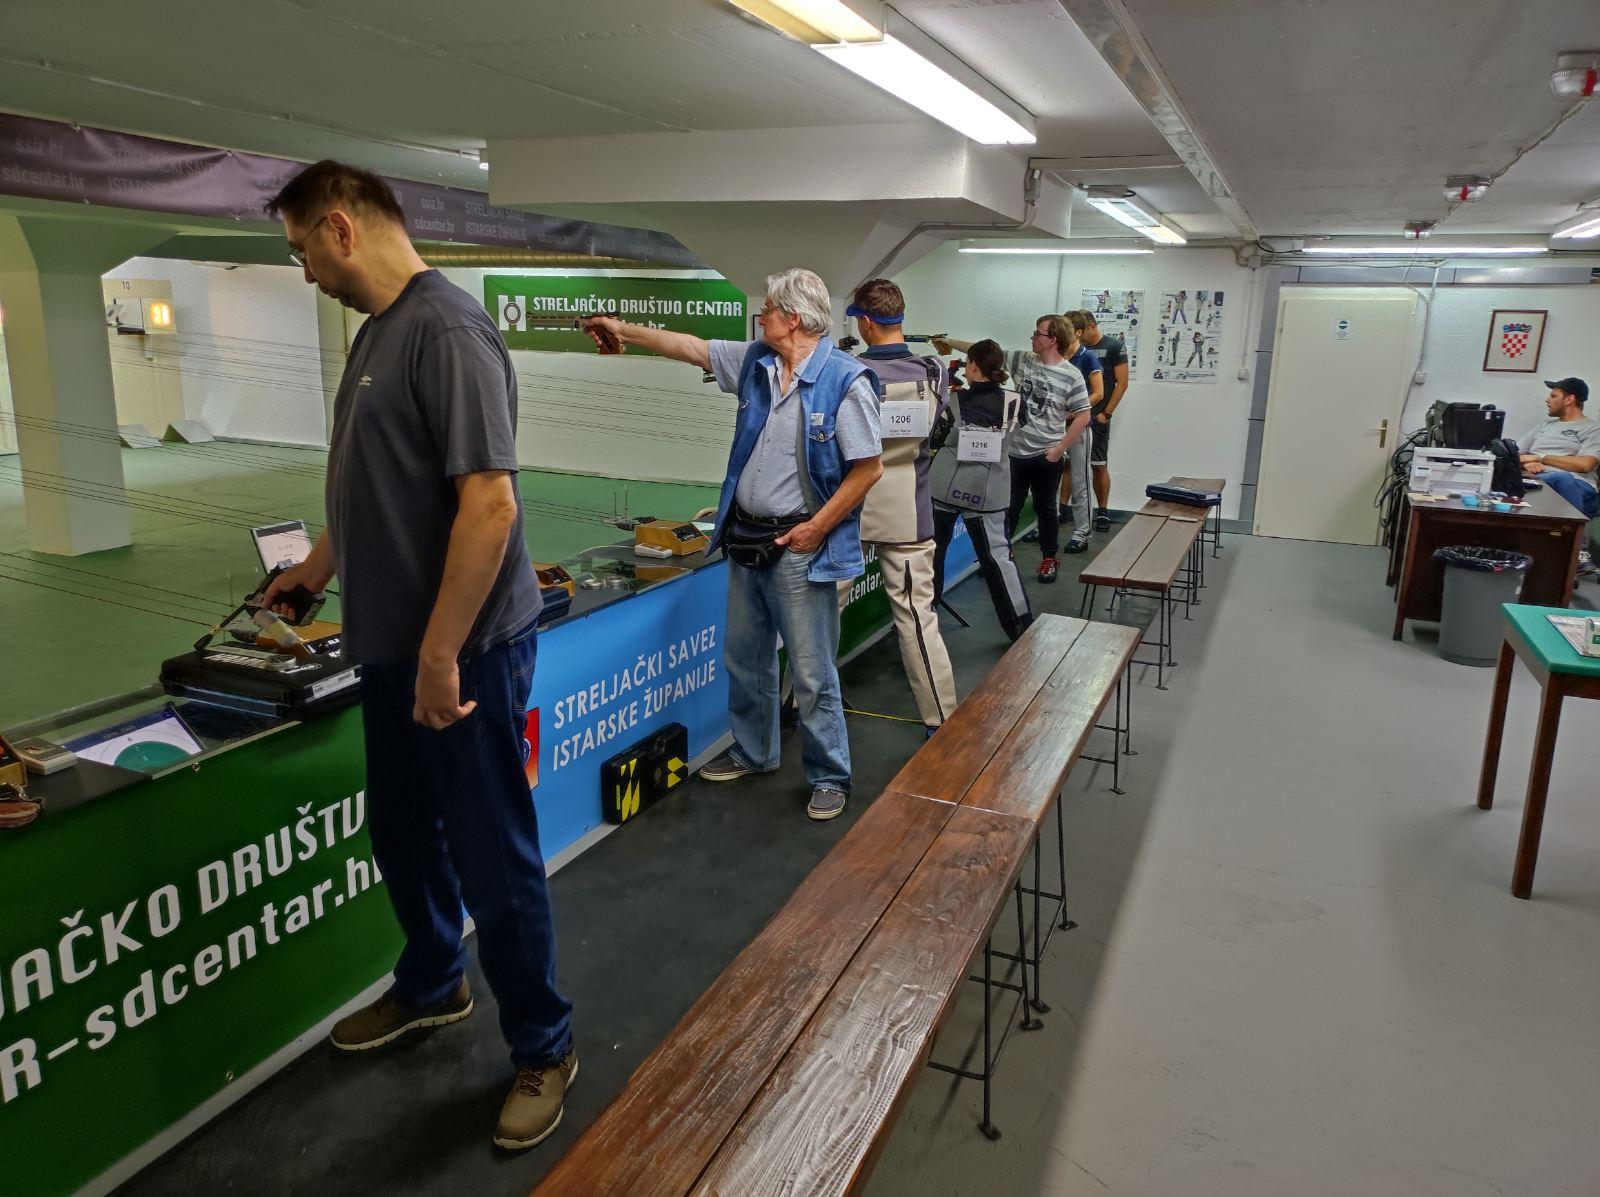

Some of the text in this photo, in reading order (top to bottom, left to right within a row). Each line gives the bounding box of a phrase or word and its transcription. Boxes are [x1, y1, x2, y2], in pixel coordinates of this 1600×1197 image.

[122, 280, 130, 290] 10
[533, 294, 743, 317] STRELJAČKO DRUŠTVO CENTAR
[890, 415, 912, 424] 1206
[971, 441, 988, 449] 1216
[952, 490, 981, 505] CRO
[846, 571, 885, 606] centar.
[554, 624, 716, 731] STRELJAČKI SAVEZ
[553, 659, 716, 772] ISTARSKE ŽUPANIJE
[0, 790, 365, 1021] AČKO DRUŠTV
[0, 854, 383, 1103] R-sdcentar.h
